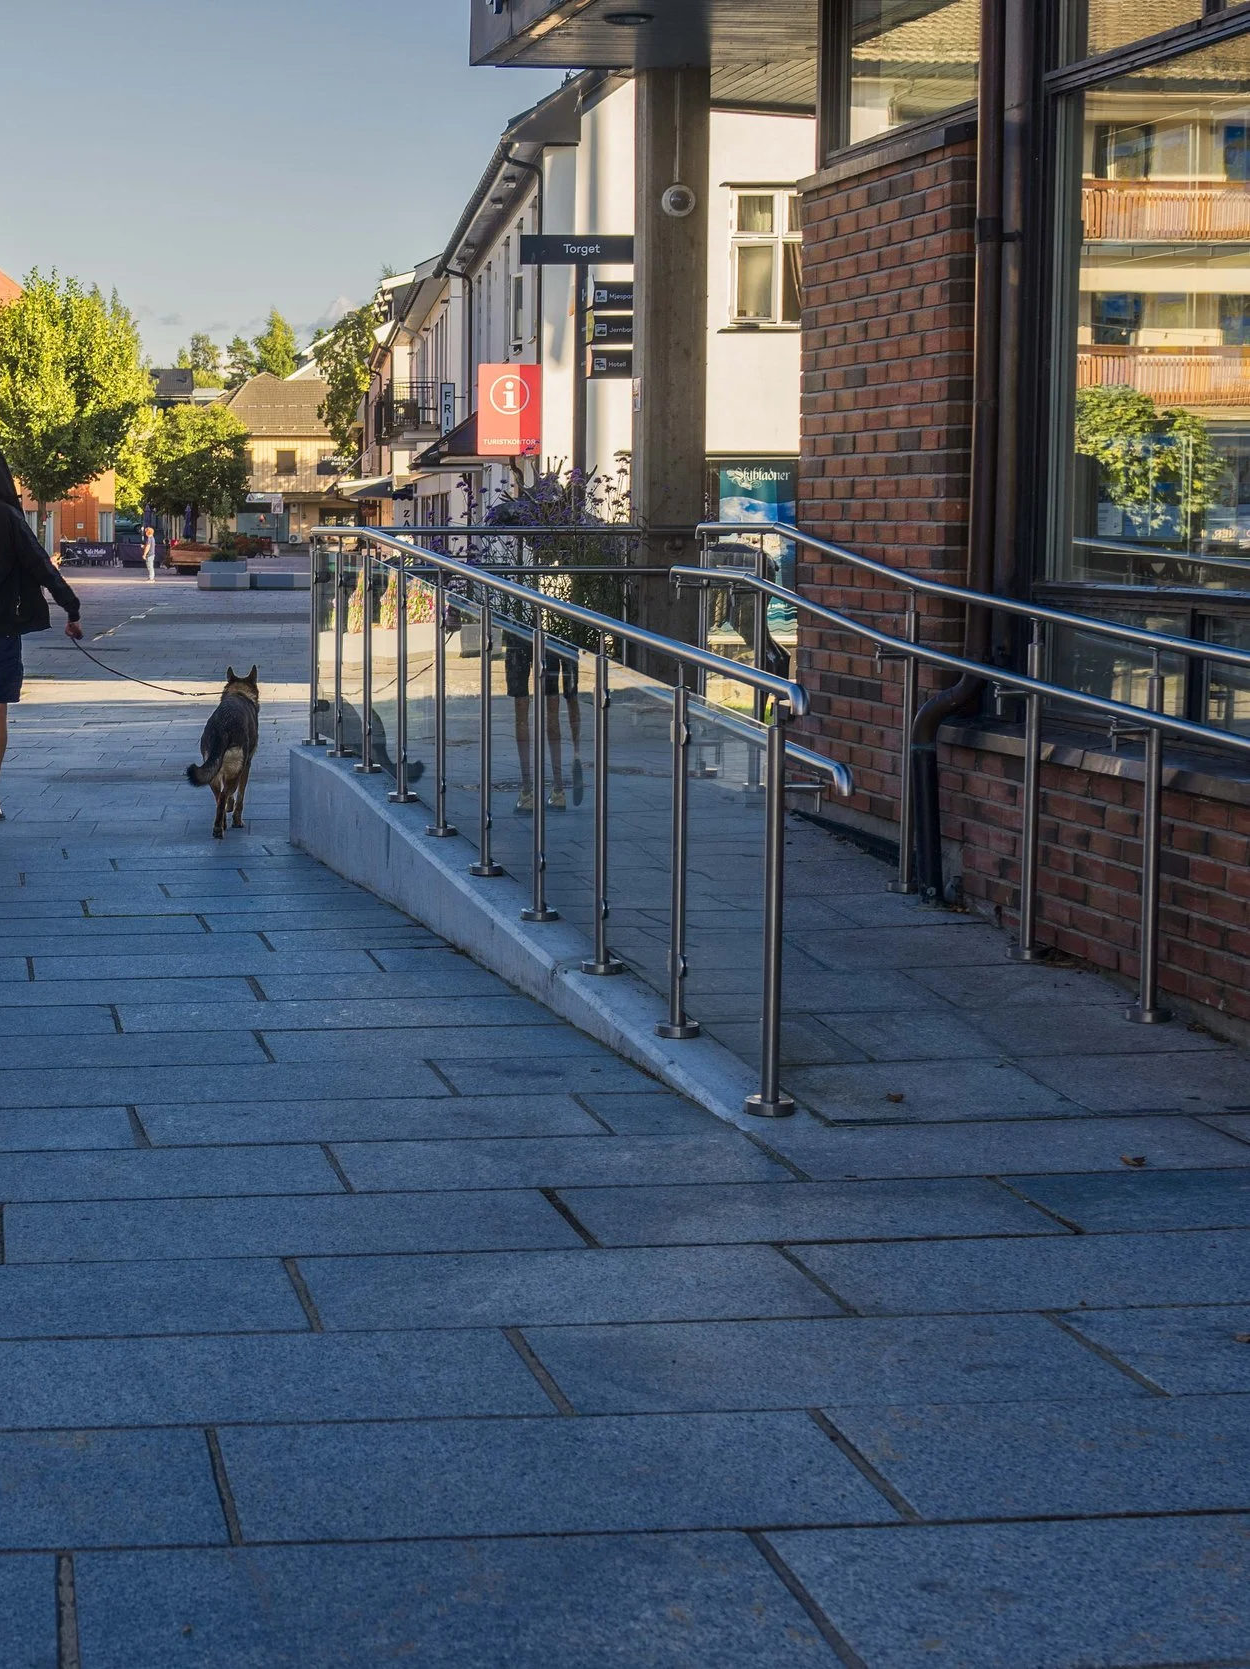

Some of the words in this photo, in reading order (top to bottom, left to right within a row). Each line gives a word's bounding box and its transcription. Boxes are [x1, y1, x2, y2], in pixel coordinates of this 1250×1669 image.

[563, 243, 601, 257] Torget
[483, 438, 536, 446] TURISTKONTOR
[735, 466, 791, 482] Skibladner
